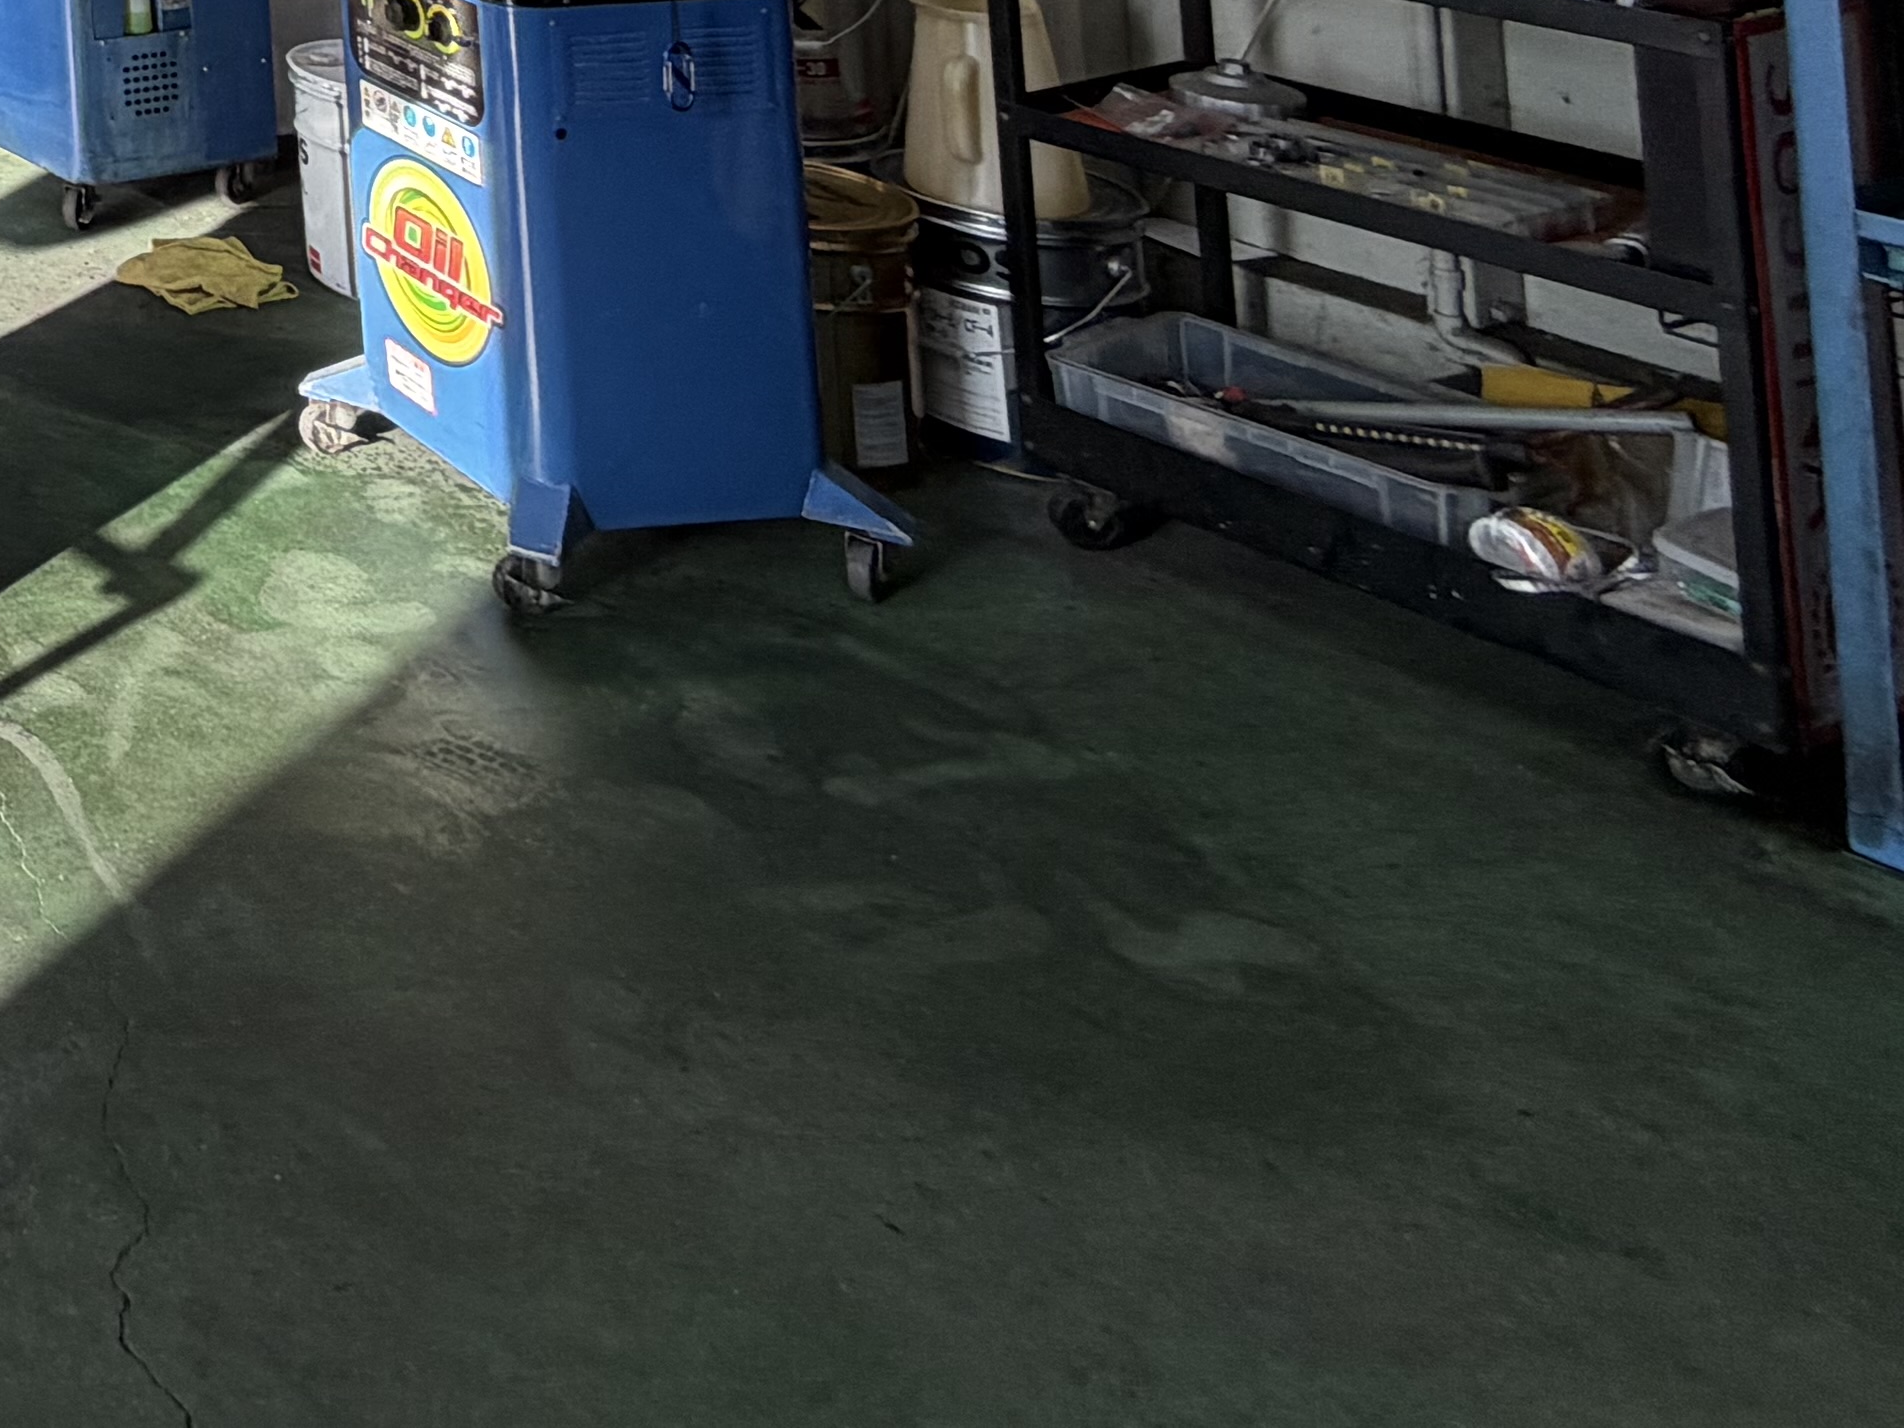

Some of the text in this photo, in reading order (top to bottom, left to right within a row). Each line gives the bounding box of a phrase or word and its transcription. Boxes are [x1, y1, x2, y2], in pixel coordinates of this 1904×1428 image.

[796, 62, 827, 76] -30
[365, 226, 504, 324] Changer
[393, 205, 464, 285] Oil
